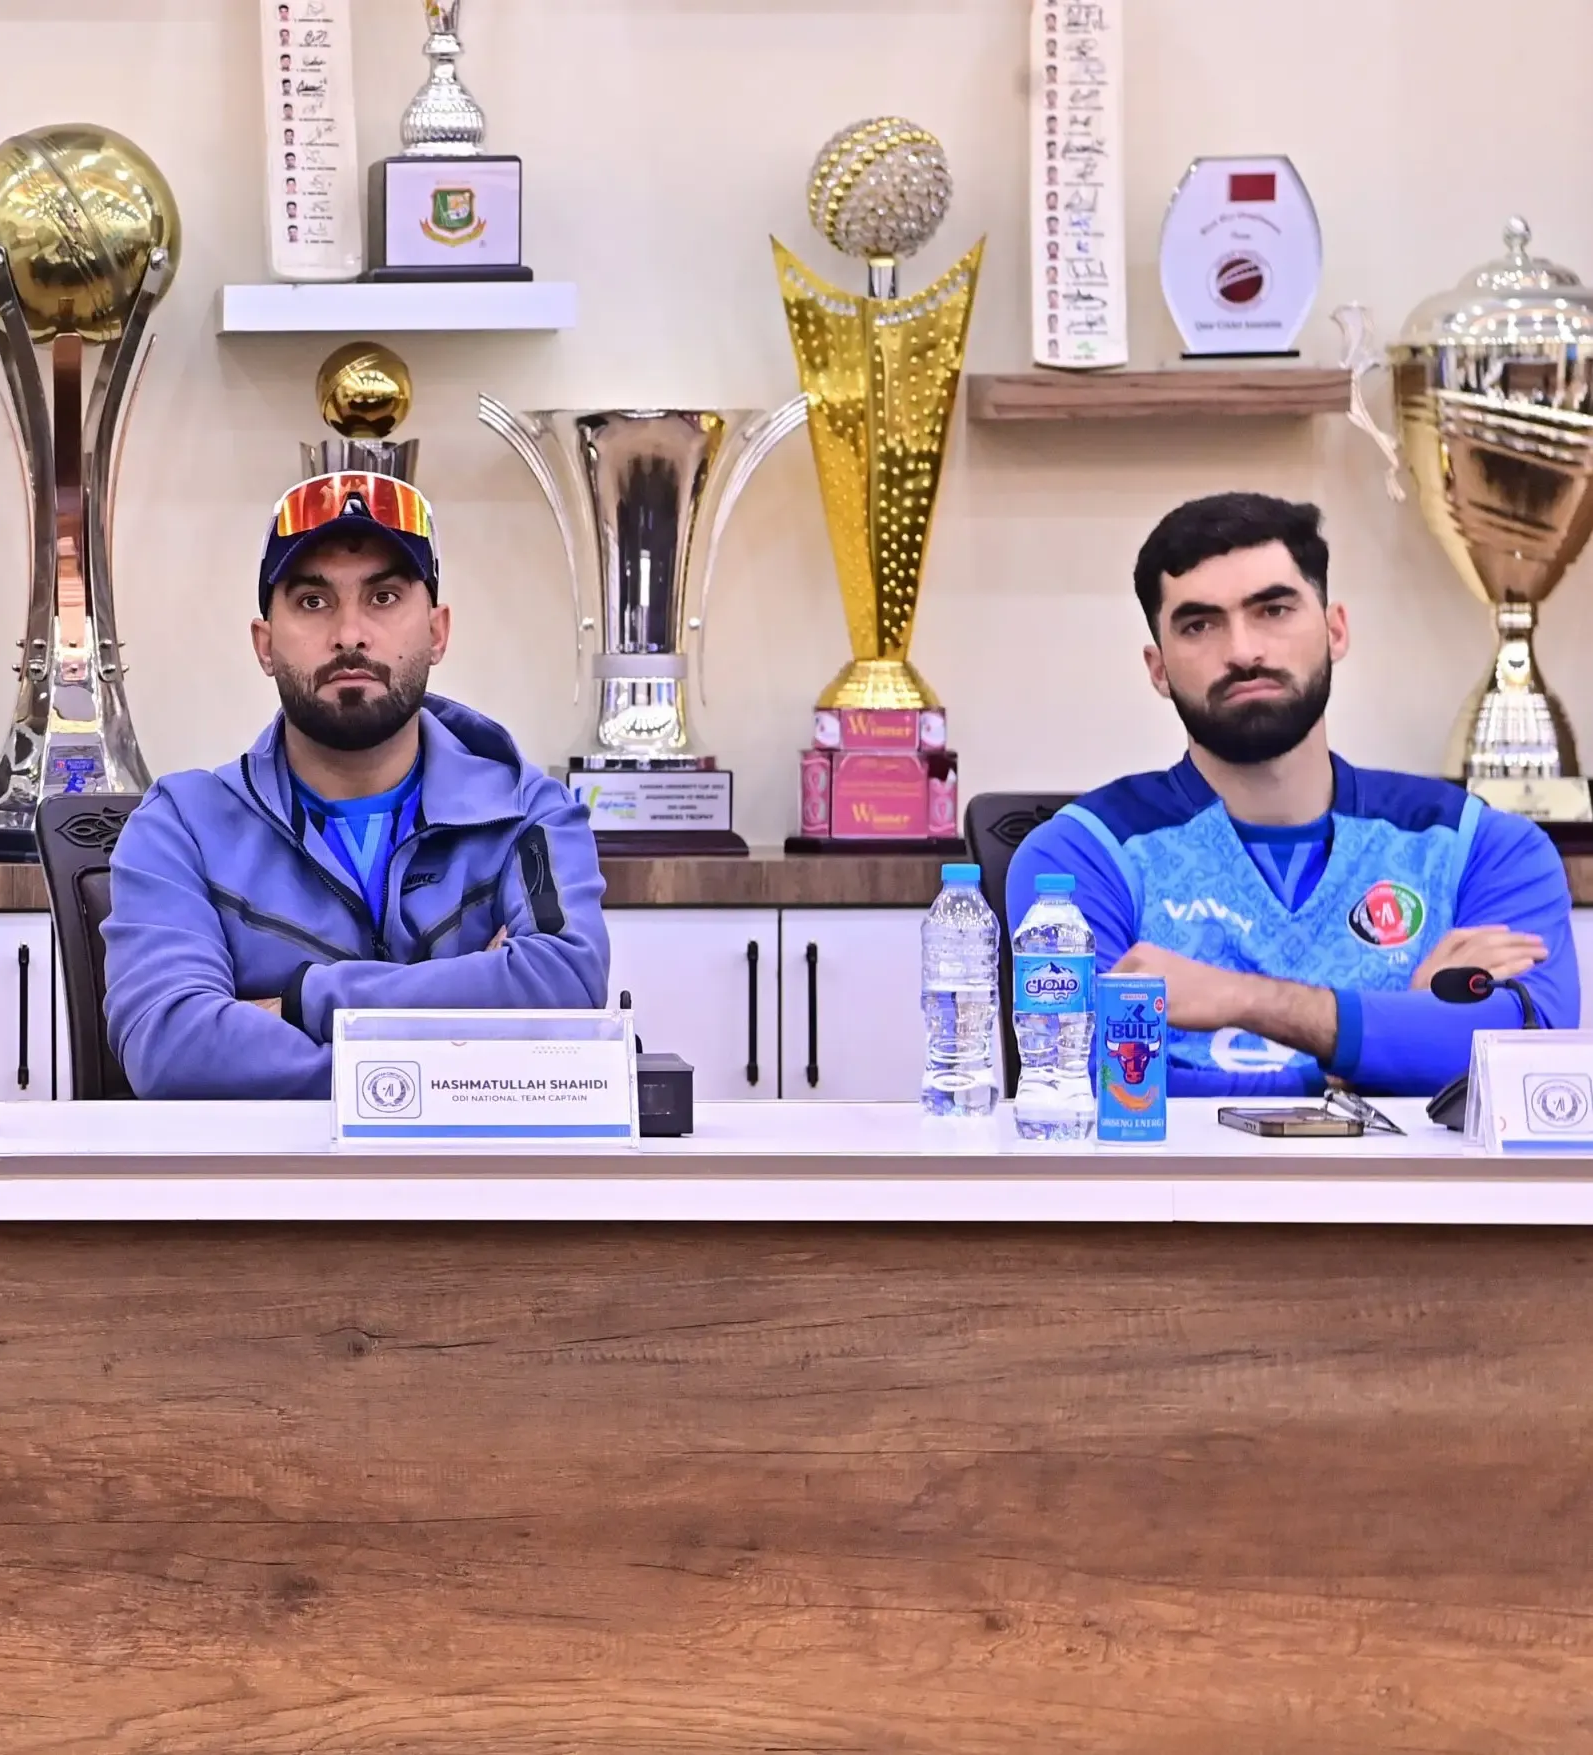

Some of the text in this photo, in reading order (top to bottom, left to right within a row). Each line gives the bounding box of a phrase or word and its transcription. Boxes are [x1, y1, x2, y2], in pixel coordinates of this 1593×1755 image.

[848, 714, 914, 737] Winner
[852, 802, 911, 824] Winner
[407, 872, 437, 885] NIKE
[1025, 978, 1078, 999] میهن
[1112, 1023, 1155, 1039] BULL
[431, 1079, 608, 1090] HASHMATULLAH SHAHIDI
